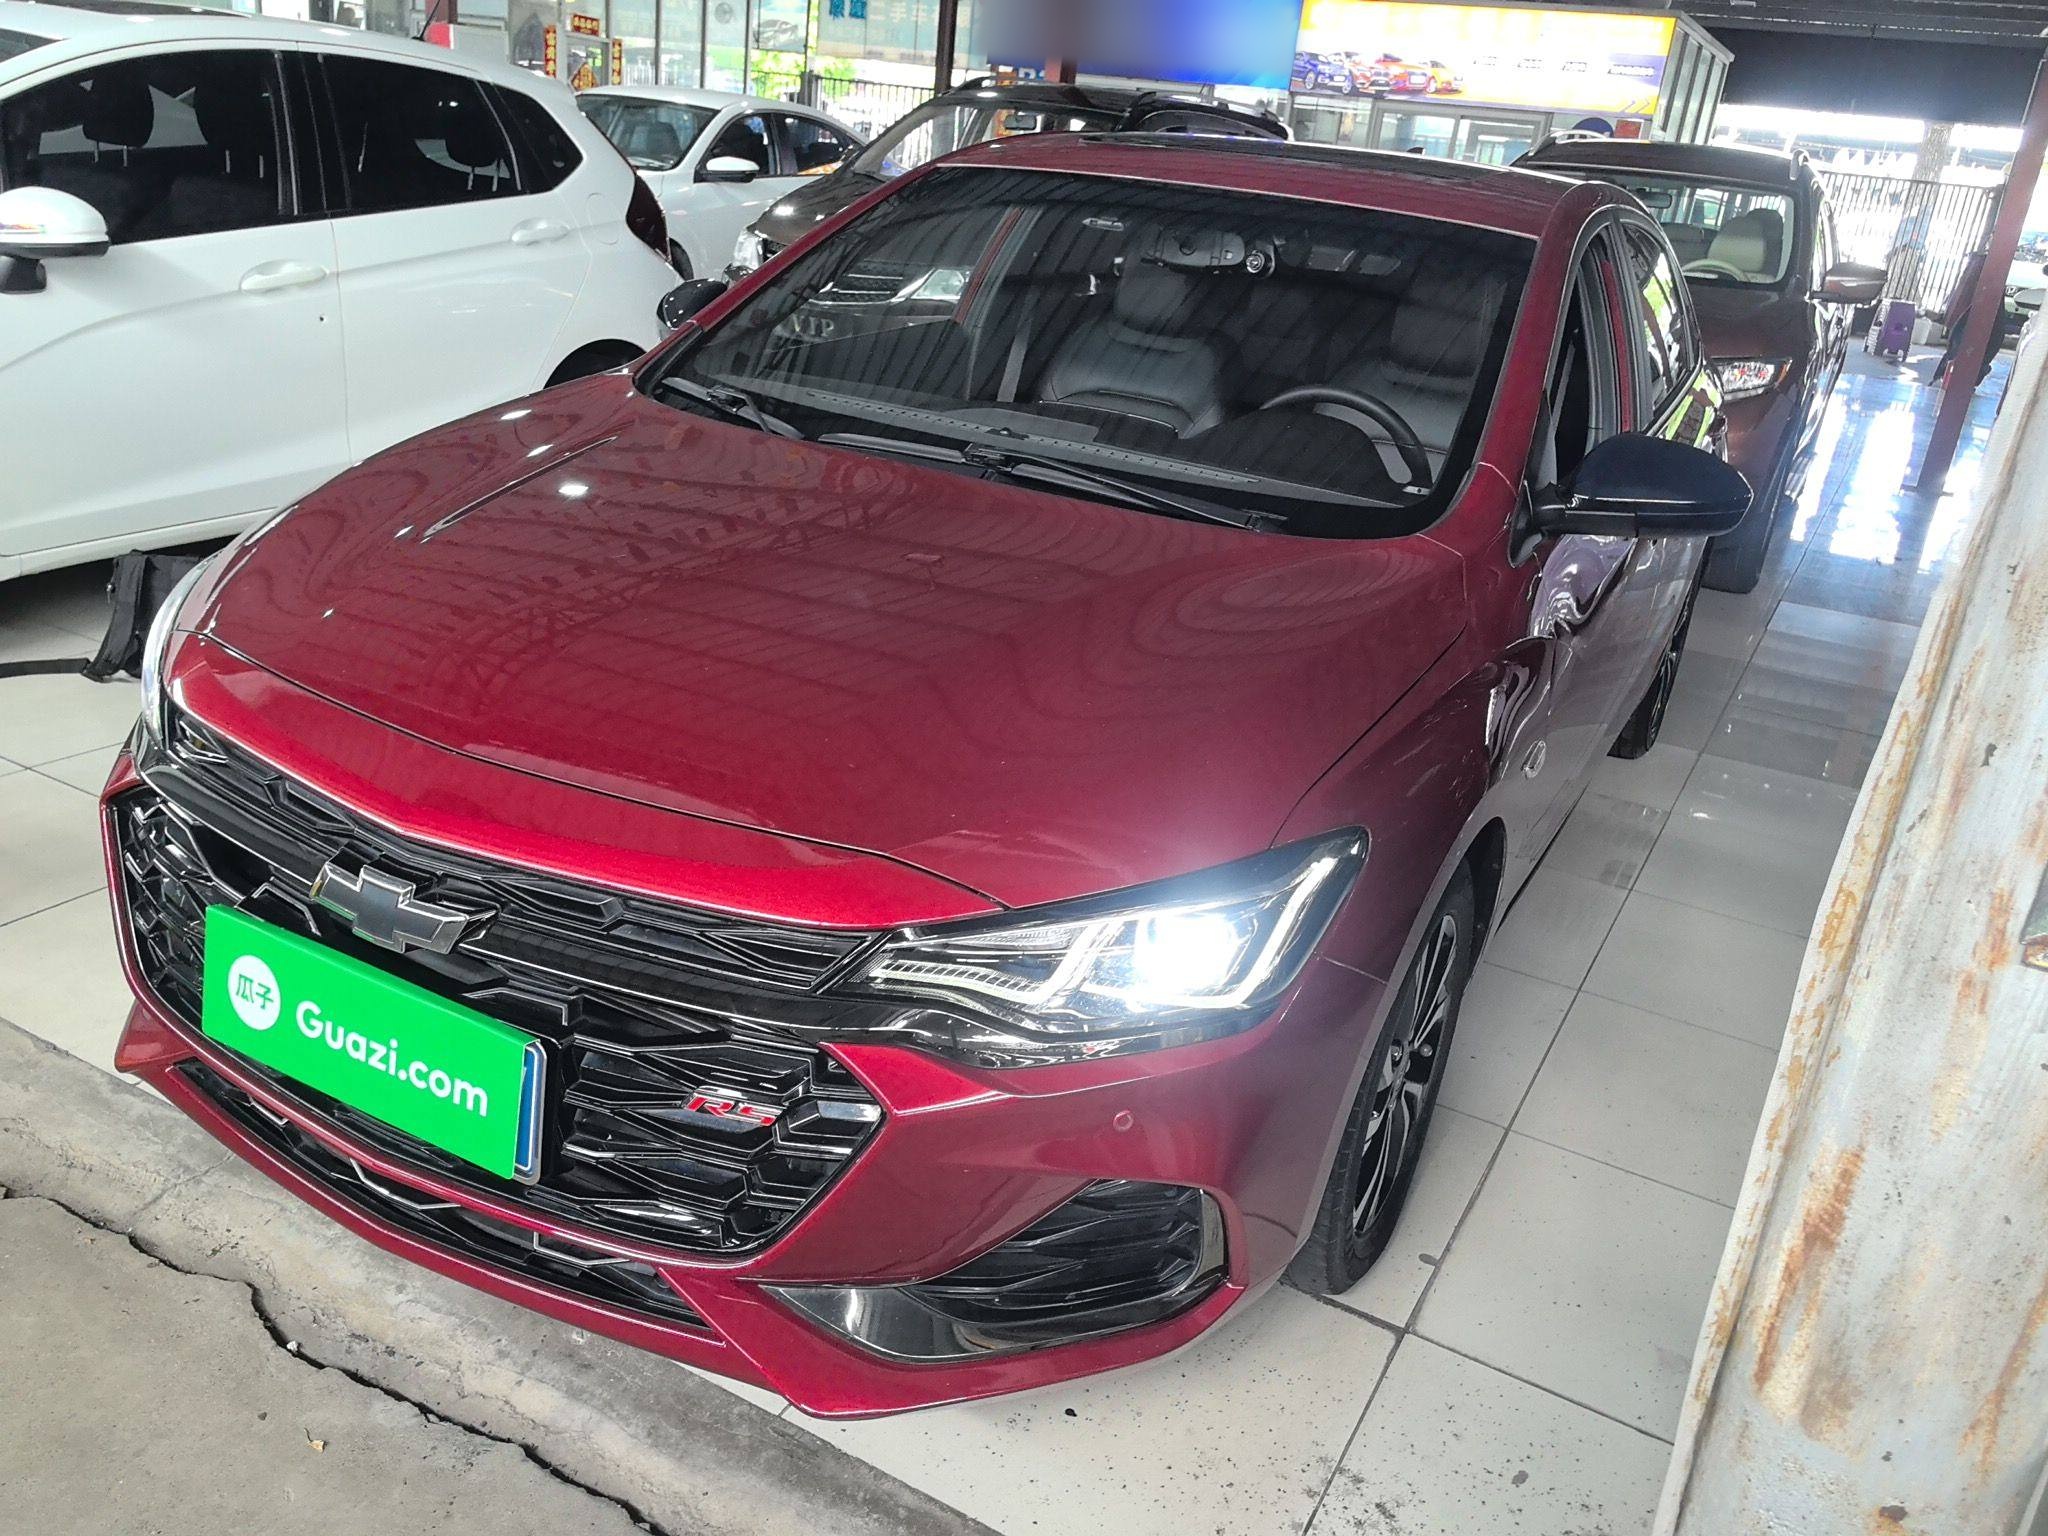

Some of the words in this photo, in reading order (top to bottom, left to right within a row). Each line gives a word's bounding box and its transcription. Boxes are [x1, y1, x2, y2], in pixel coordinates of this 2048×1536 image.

[792, 313, 835, 337] VIP
[236, 973, 274, 1010] 瓜子
[296, 1000, 488, 1117] Guazi.com
[683, 1092, 784, 1127] RS
